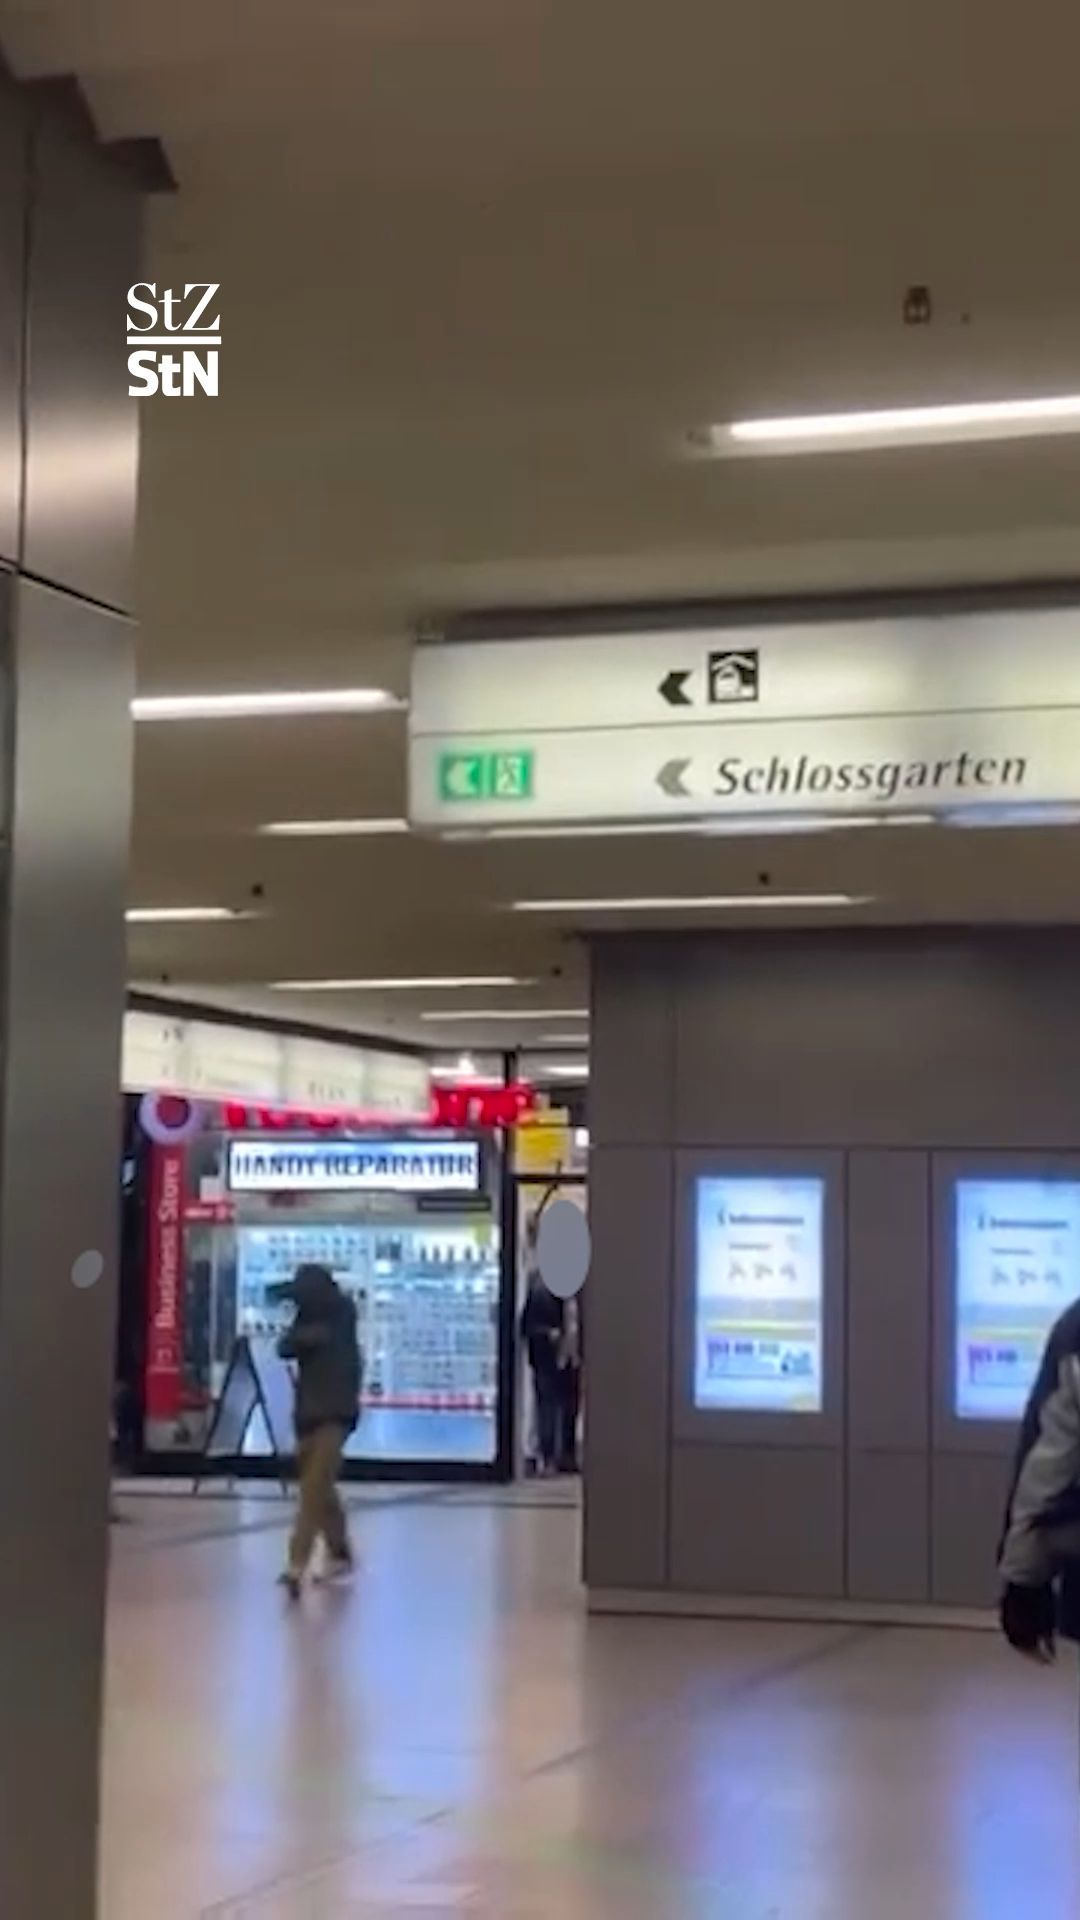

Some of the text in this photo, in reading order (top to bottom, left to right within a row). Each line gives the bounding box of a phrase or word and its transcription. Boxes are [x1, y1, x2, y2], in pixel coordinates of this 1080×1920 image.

[713, 752, 1028, 801] Schlossgarten
[235, 1153, 473, 1177] HANDY REPARATUR
[156, 1158, 180, 1329] Business Store
